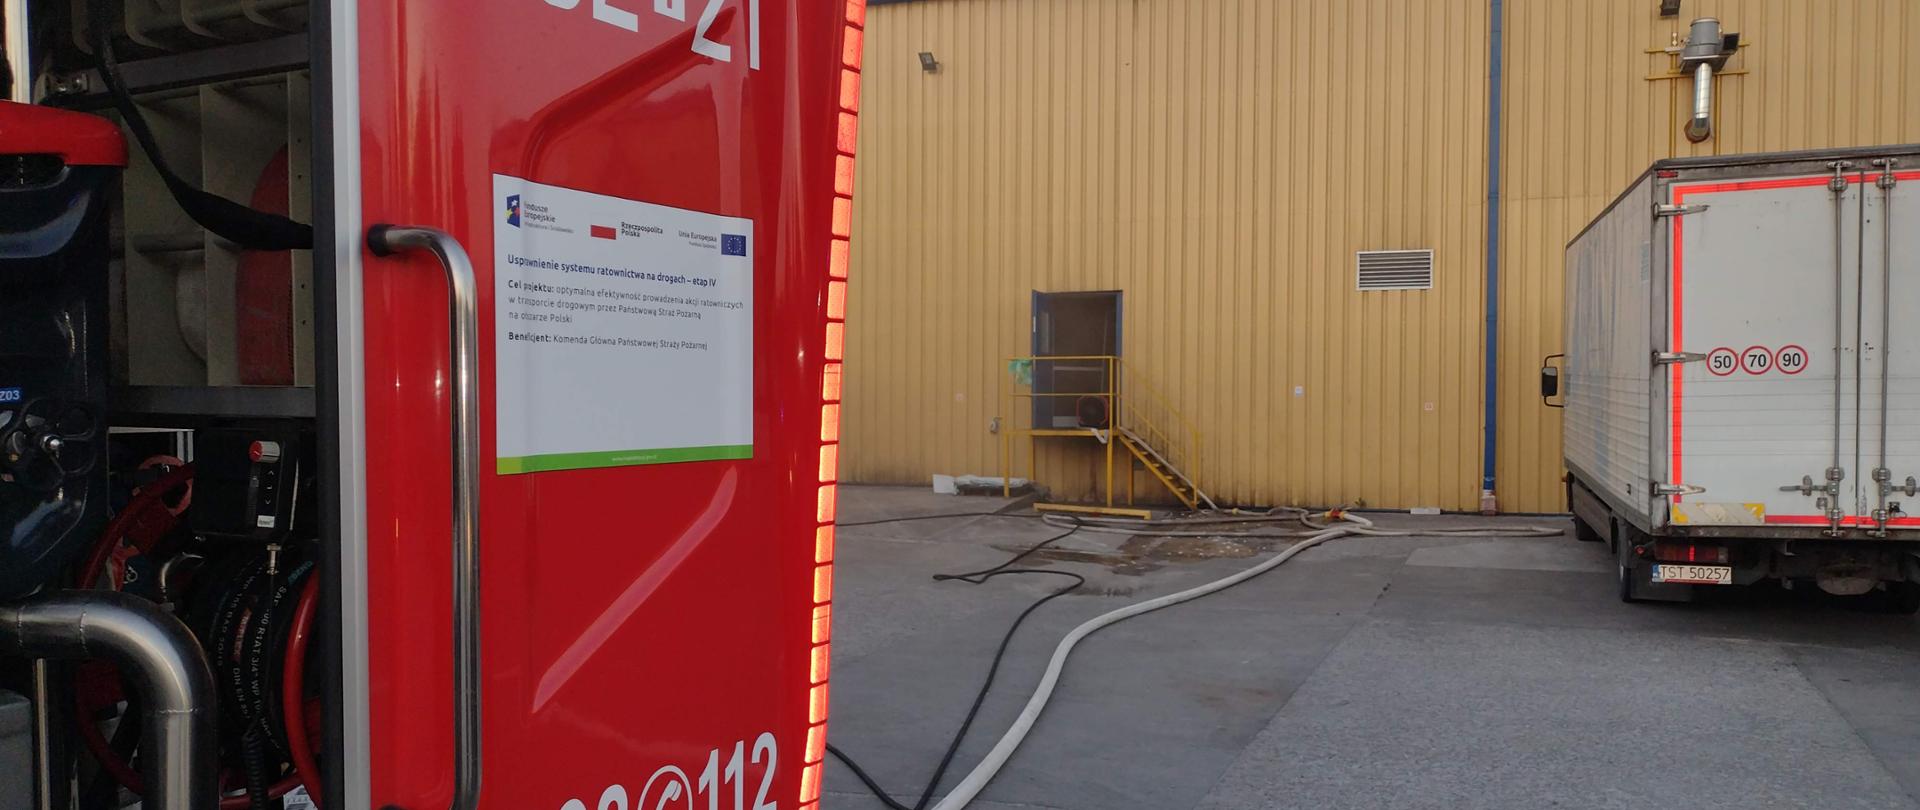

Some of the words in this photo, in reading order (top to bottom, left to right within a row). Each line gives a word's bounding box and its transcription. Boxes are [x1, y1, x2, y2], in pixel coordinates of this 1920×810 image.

[621, 221, 663, 234] Rzeczpospolita
[621, 228, 640, 238] Polska
[561, 263, 595, 274] systemu
[597, 268, 645, 280] ratownictwa
[647, 273, 656, 281] na
[657, 272, 686, 285] drogach
[693, 278, 708, 288] etap
[709, 279, 717, 287] IV
[508, 280, 521, 289] Cel
[556, 286, 595, 297] optymalna
[643, 293, 684, 304] prowadzenia
[685, 297, 699, 306] akcji
[700, 299, 744, 310] ratowniczych
[556, 300, 596, 311] drogowym
[597, 304, 617, 313] przez
[509, 311, 518, 319] na
[550, 313, 573, 323] Polski
[553, 334, 587, 345] Komenda
[1714, 355, 1732, 369] 50
[1748, 354, 1767, 367] 70
[1782, 353, 1801, 367] 90
[1661, 566, 1684, 578] TST
[1689, 567, 1730, 580] 50257
